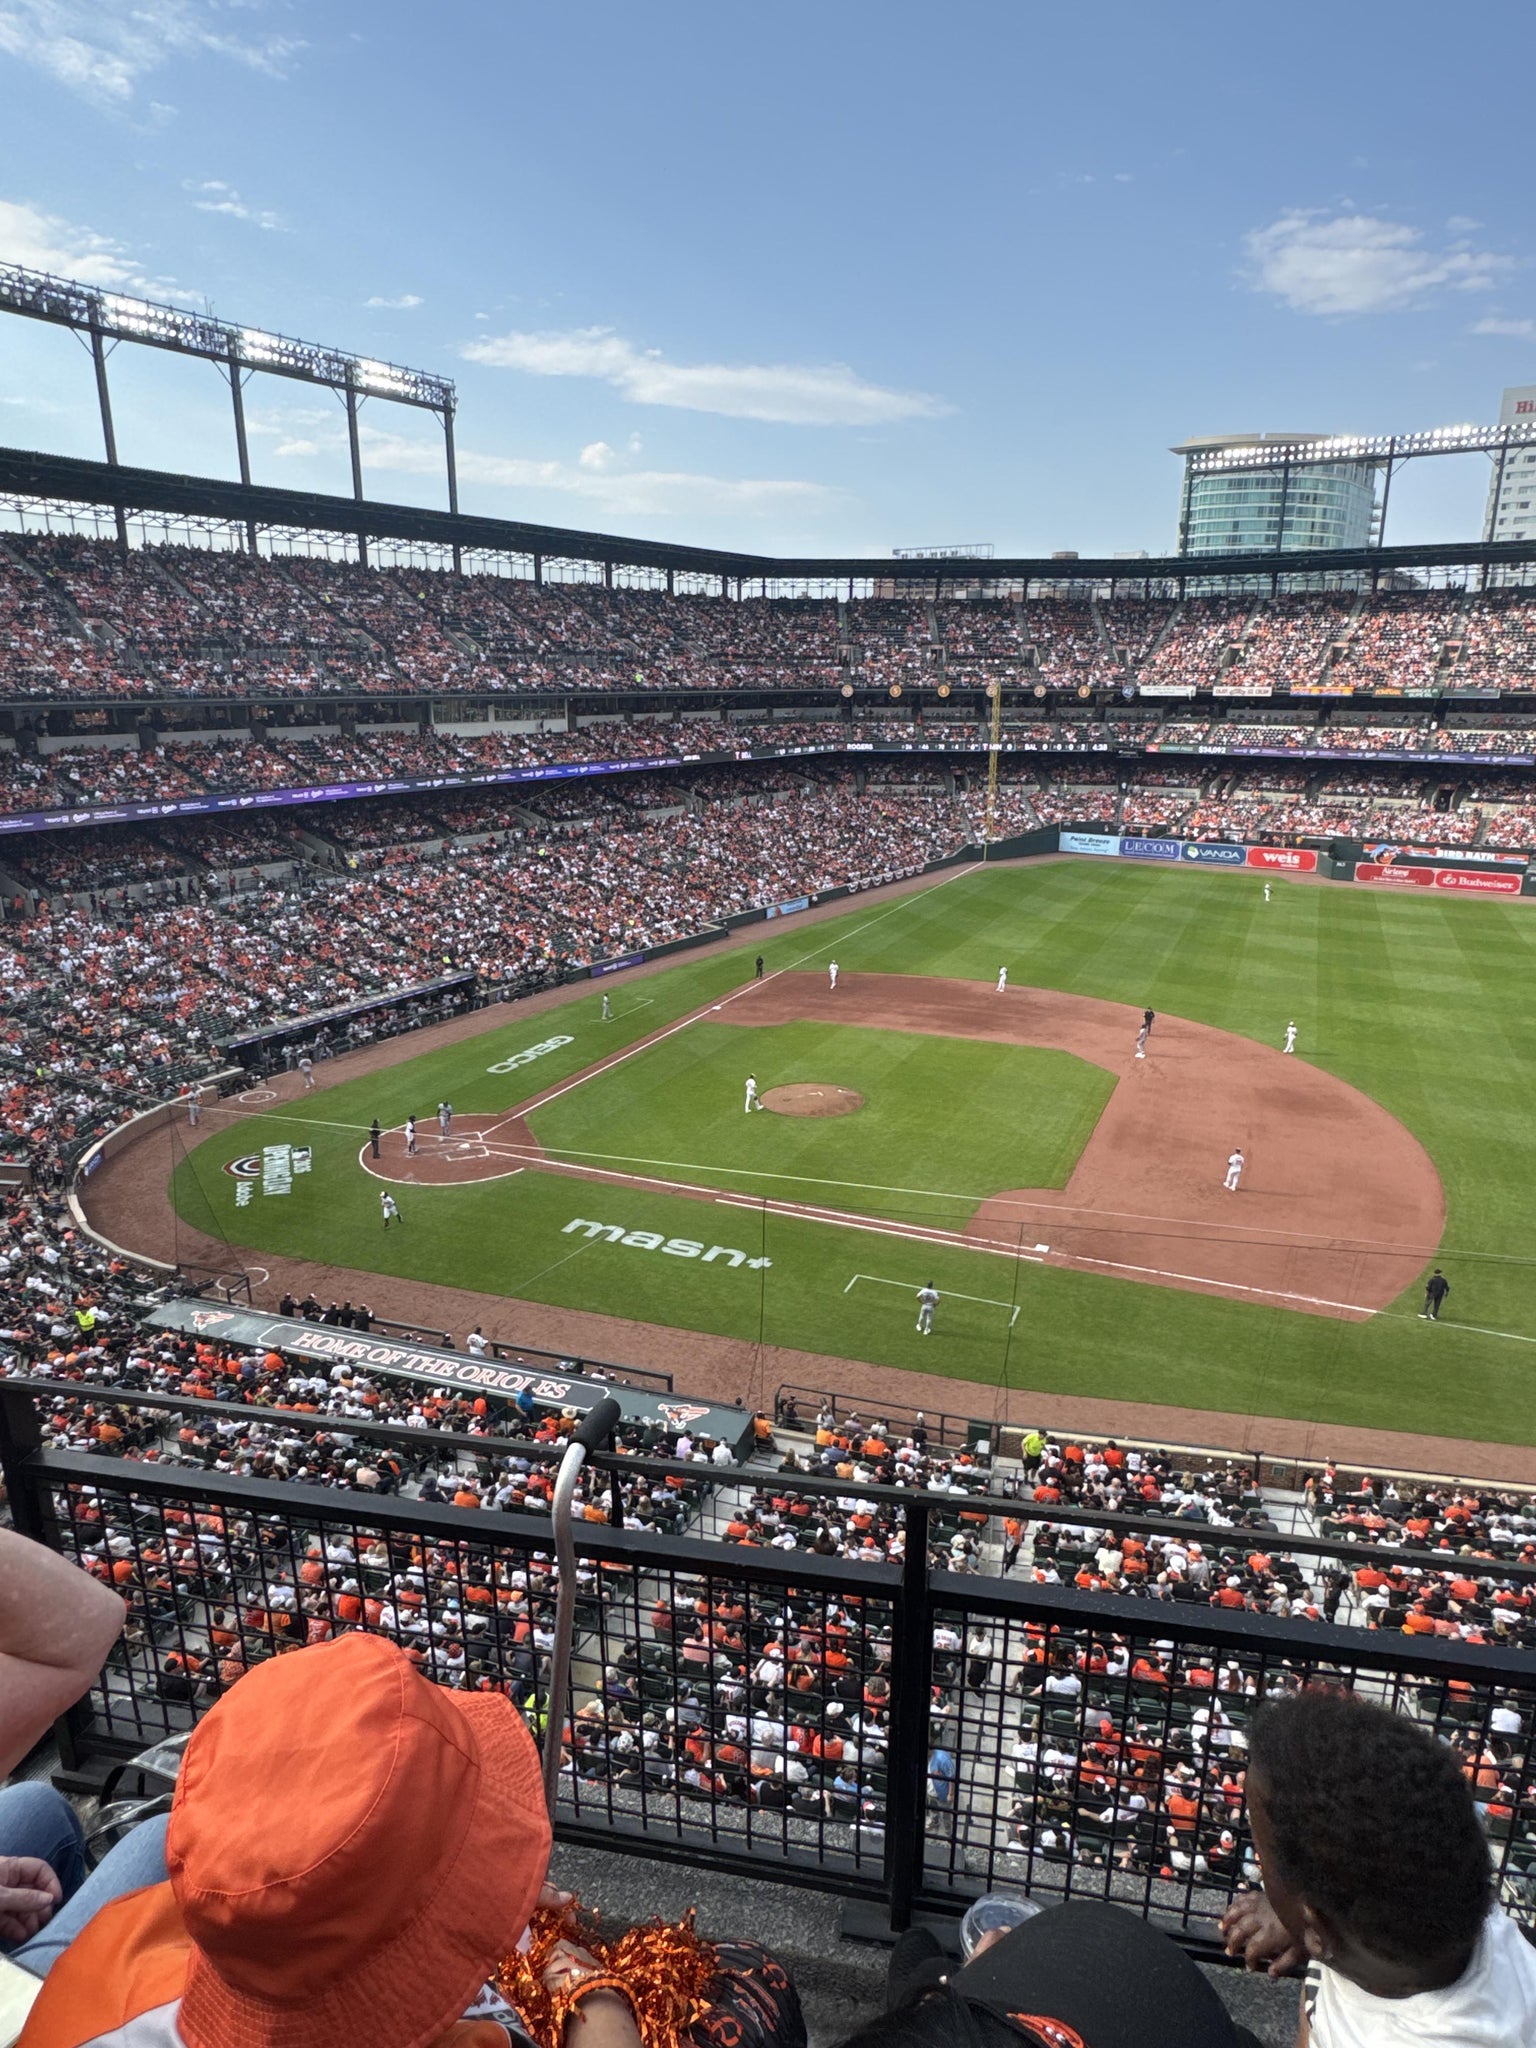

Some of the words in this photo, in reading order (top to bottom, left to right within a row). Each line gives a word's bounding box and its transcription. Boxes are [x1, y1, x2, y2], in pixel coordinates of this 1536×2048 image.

[1516, 400, 1536, 414] Hi
[1124, 841, 1175, 854] LECOM
[1200, 848, 1241, 859] VANDA
[1262, 851, 1300, 865] weis
[1436, 849, 1464, 858] BIRD
[1466, 851, 1495, 861] BATH
[1458, 876, 1514, 889] Budweiser
[486, 1035, 575, 1074] GEICO
[561, 1218, 773, 1270] masn+
[290, 1332, 371, 1359] HOME
[367, 1347, 407, 1365] OF
[402, 1354, 460, 1376] THE
[456, 1365, 571, 1399] ORIOLES
